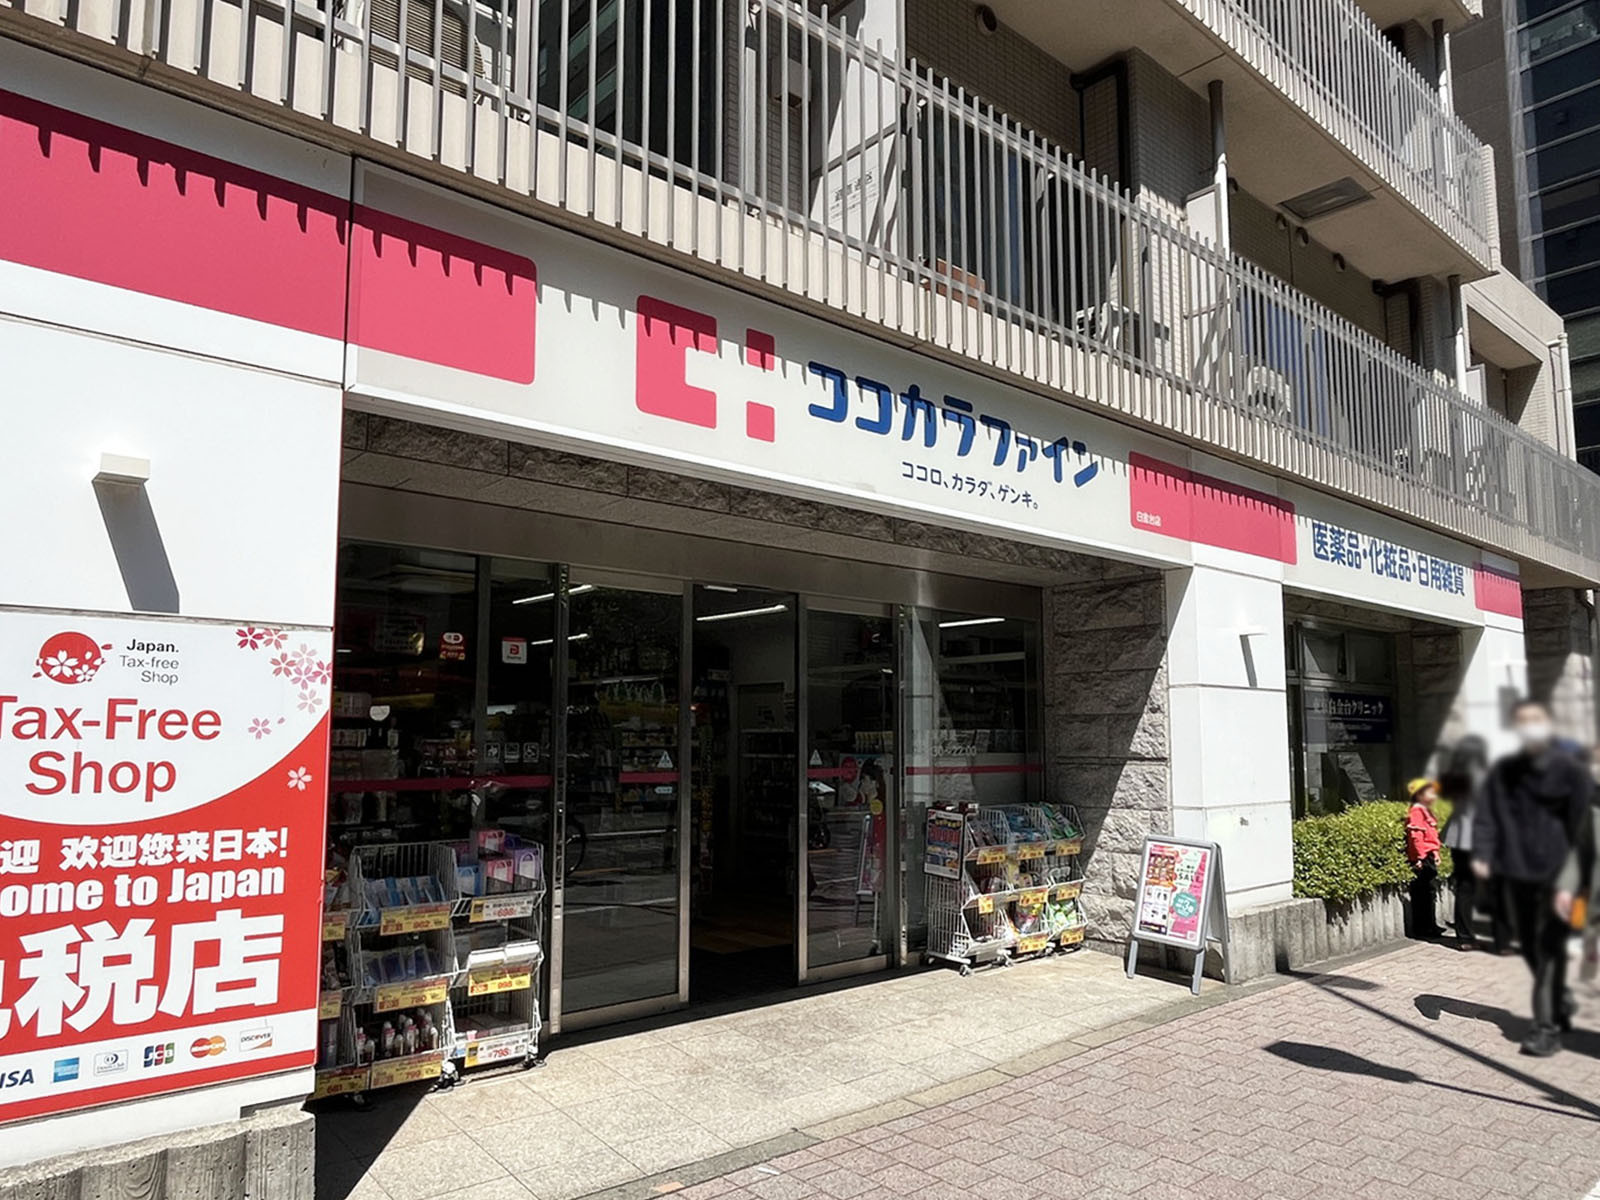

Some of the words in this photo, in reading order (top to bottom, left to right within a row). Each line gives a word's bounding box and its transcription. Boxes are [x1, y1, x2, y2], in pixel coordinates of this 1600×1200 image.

[808, 361, 1099, 487] ココカラファイン
[902, 460, 1040, 510] ココロ、カラダ、ゲンキ。
[1312, 521, 1465, 597] 医薬品・化粧品・日用雑貨
[119, 655, 179, 669] Tax-free
[126, 638, 179, 654] Japan.
[141, 670, 179, 685] Shop
[25, 751, 177, 803] Shop
[59, 827, 288, 871] 欢迎您来日本!
[114, 873, 158, 907] to
[167, 866, 285, 904] Japan
